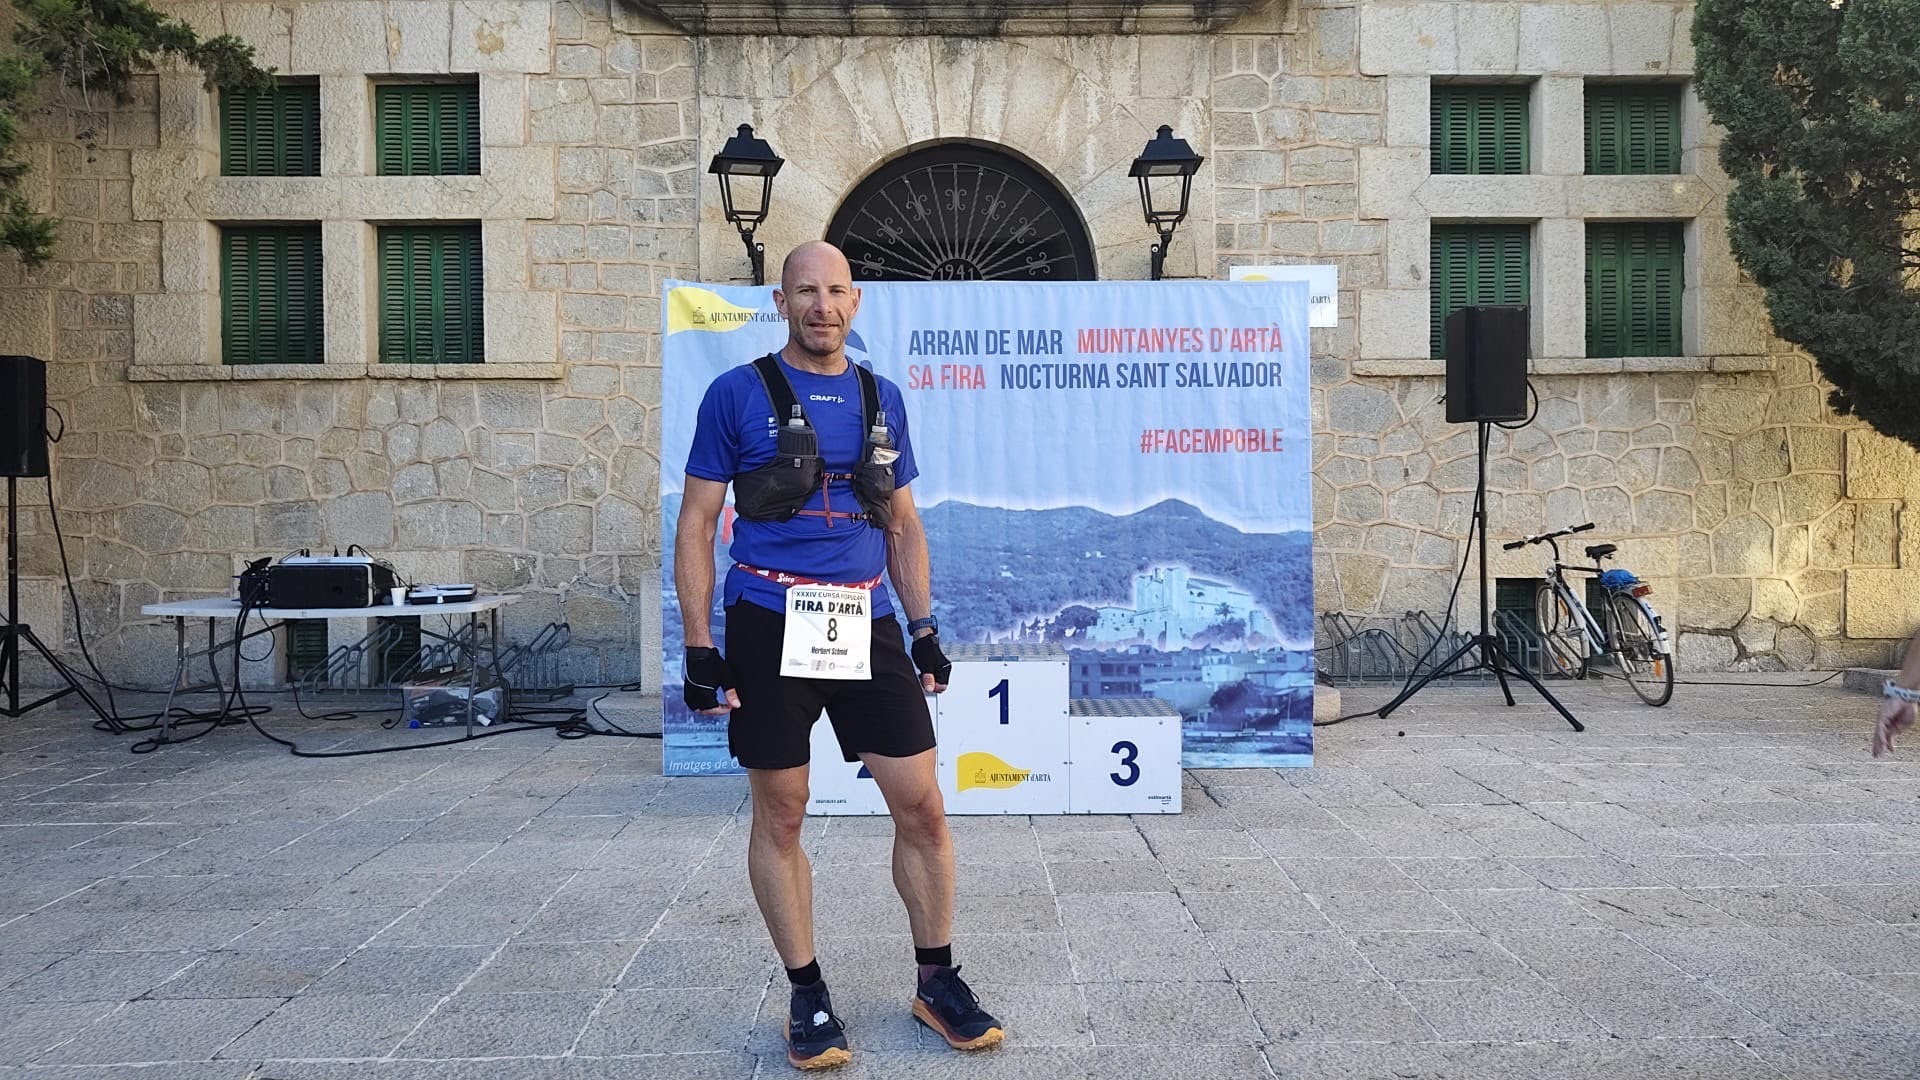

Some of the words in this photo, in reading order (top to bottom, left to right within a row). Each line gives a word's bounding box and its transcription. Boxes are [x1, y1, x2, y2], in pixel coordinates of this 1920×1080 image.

[937, 264, 974, 280] 1941
[709, 312, 759, 324] AJUNTAMENT
[908, 329, 978, 356] ARRAN
[985, 329, 1011, 355] DE
[1017, 329, 1063, 355] MAR
[1077, 327, 1204, 354] MUNTANYES
[1210, 321, 1284, 353] D'ARTÀ
[907, 364, 935, 390] SA
[941, 364, 986, 390] FIRA
[1001, 363, 1111, 390] NOCTURNA
[1116, 362, 1170, 389] SANT
[1175, 361, 1282, 388] SALVADOR
[810, 394, 837, 402] CRAFT
[1140, 428, 1284, 453] #FACEMPOBLE
[794, 599, 824, 612] FIRA
[828, 601, 864, 615] D'ARTÀ
[827, 618, 838, 642] 8
[988, 679, 1010, 725] 1
[669, 760, 711, 773] Imatges
[714, 759, 728, 769] de
[1110, 740, 1141, 787] 3
[990, 773, 1029, 783] AJUNTAMENT
